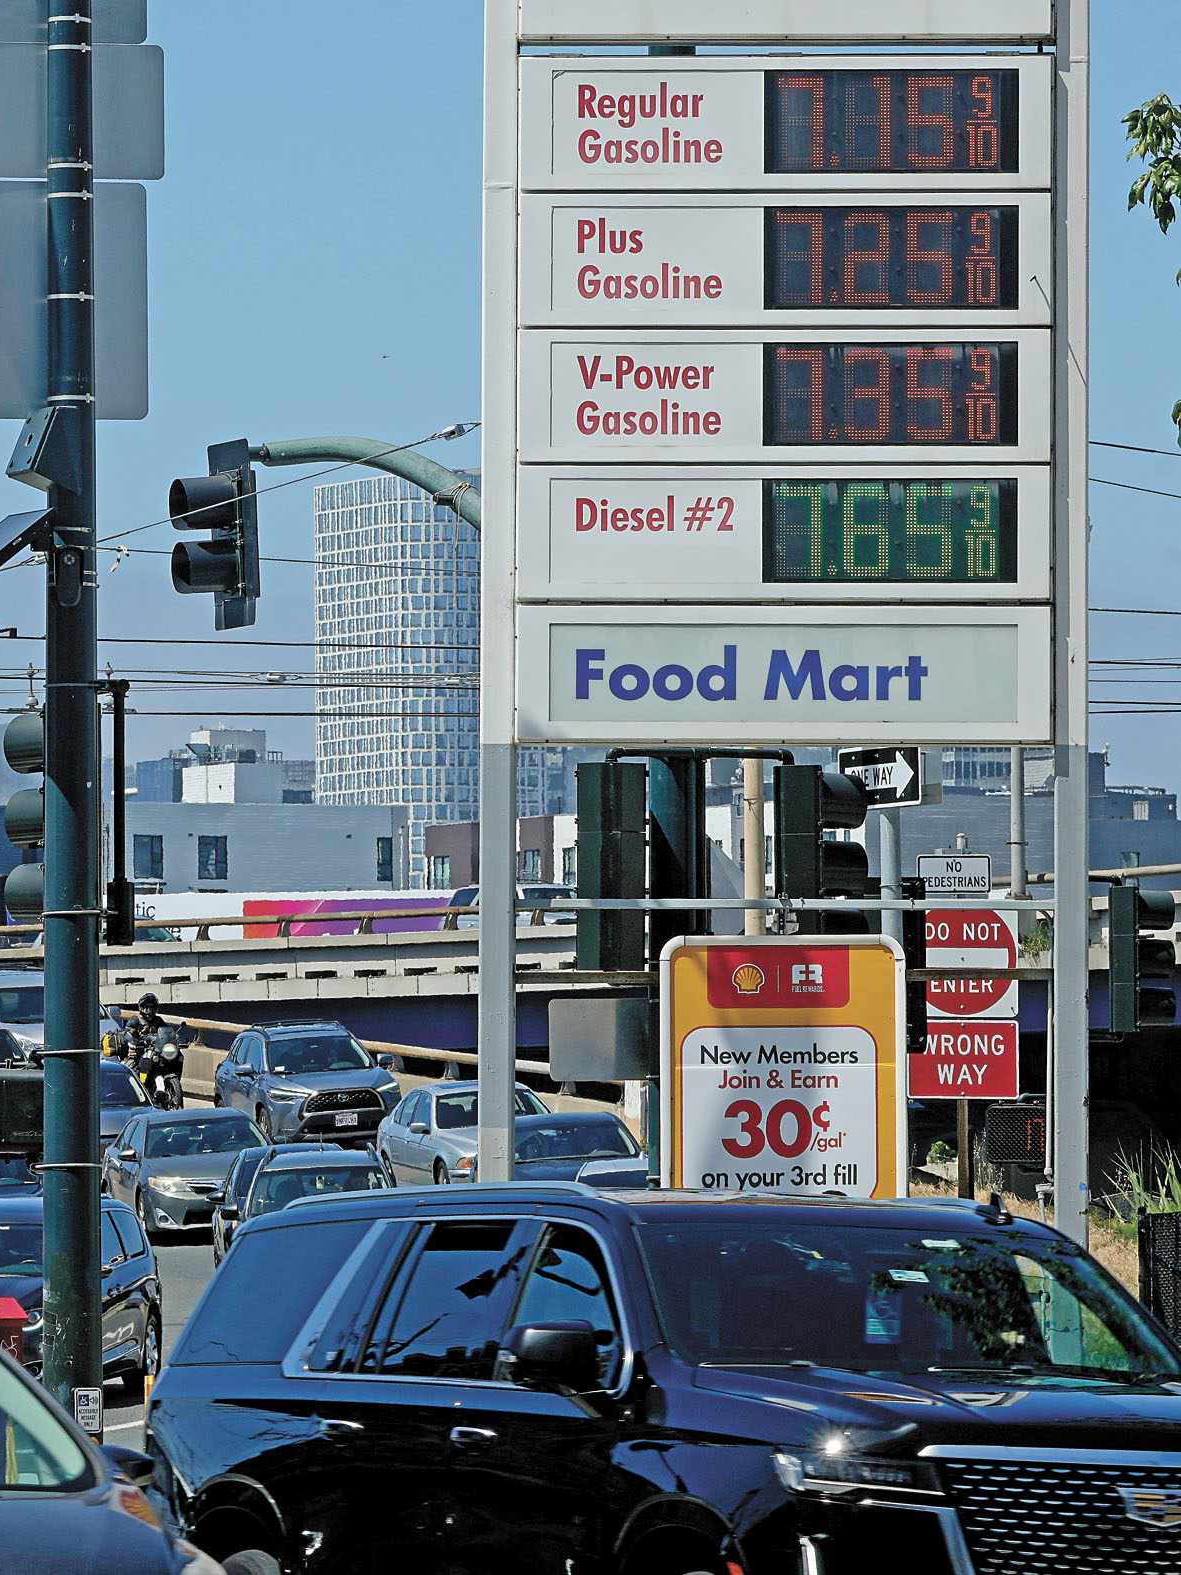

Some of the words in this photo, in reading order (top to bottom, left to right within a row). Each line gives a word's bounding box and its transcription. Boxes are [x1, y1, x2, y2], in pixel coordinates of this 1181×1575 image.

[577, 81, 704, 127] Regular
[777, 76, 954, 167] 7.15
[577, 127, 723, 164] Gasoline
[577, 217, 644, 254] Plus
[776, 212, 953, 303] 7.25
[577, 262, 723, 299] Gasoline
[577, 355, 715, 390] V-Power
[775, 348, 953, 440] 7.35
[576, 398, 722, 436] Gasoline
[575, 495, 675, 532] Diesel
[683, 496, 735, 532] #2
[775, 485, 953, 577] 7.65
[575, 644, 738, 702] Food
[764, 649, 928, 702] Mart
[872, 765, 894, 787] WAY
[946, 861, 962, 873] NO
[925, 922, 950, 941] DO
[963, 922, 1001, 941] NOT
[700, 1044, 752, 1065] New
[757, 1042, 859, 1065] Members
[921, 1033, 1006, 1056] WRONG
[718, 1069, 761, 1089] Join
[766, 1069, 784, 1089] &
[790, 1069, 839, 1089] Earn
[937, 1063, 988, 1086] WAY
[701, 1171, 729, 1188] on
[735, 1171, 785, 1190] your
[790, 1164, 827, 1187] 3rd
[833, 1163, 858, 1186] fill
